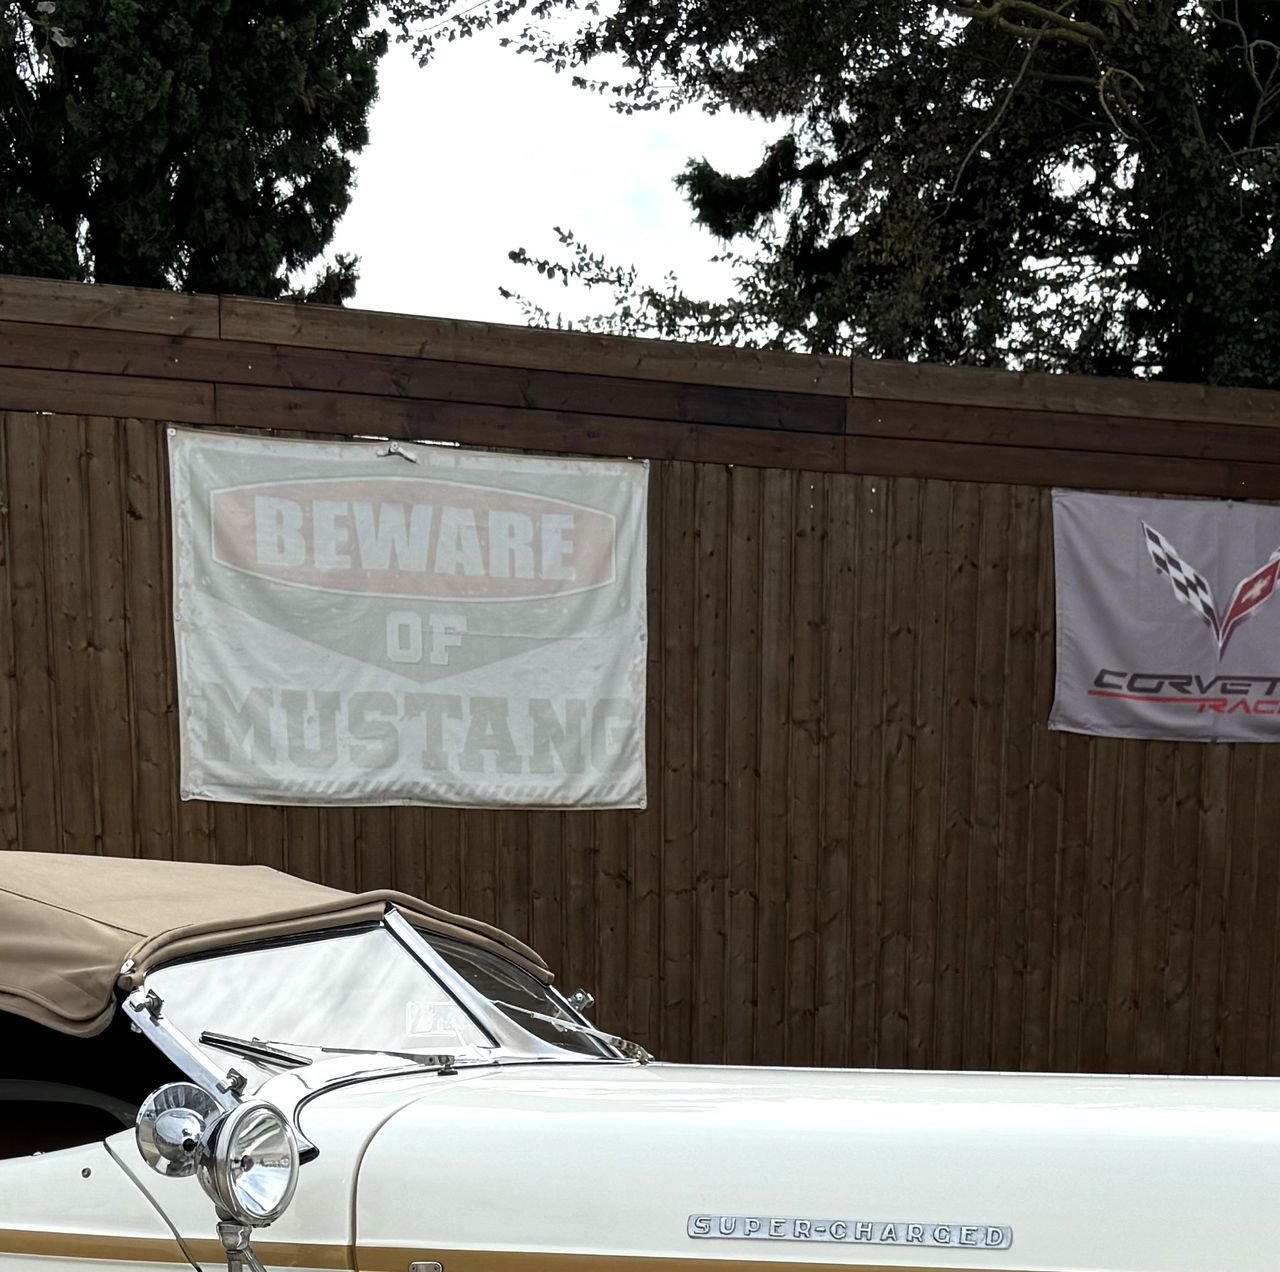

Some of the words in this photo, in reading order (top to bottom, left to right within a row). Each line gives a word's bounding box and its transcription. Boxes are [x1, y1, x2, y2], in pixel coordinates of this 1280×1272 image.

[254, 495, 577, 581] BEWARE
[385, 610, 467, 667] OF
[200, 682, 637, 776] MUSTANG
[692, 1215, 1006, 1248] SUPER-CHARGED
